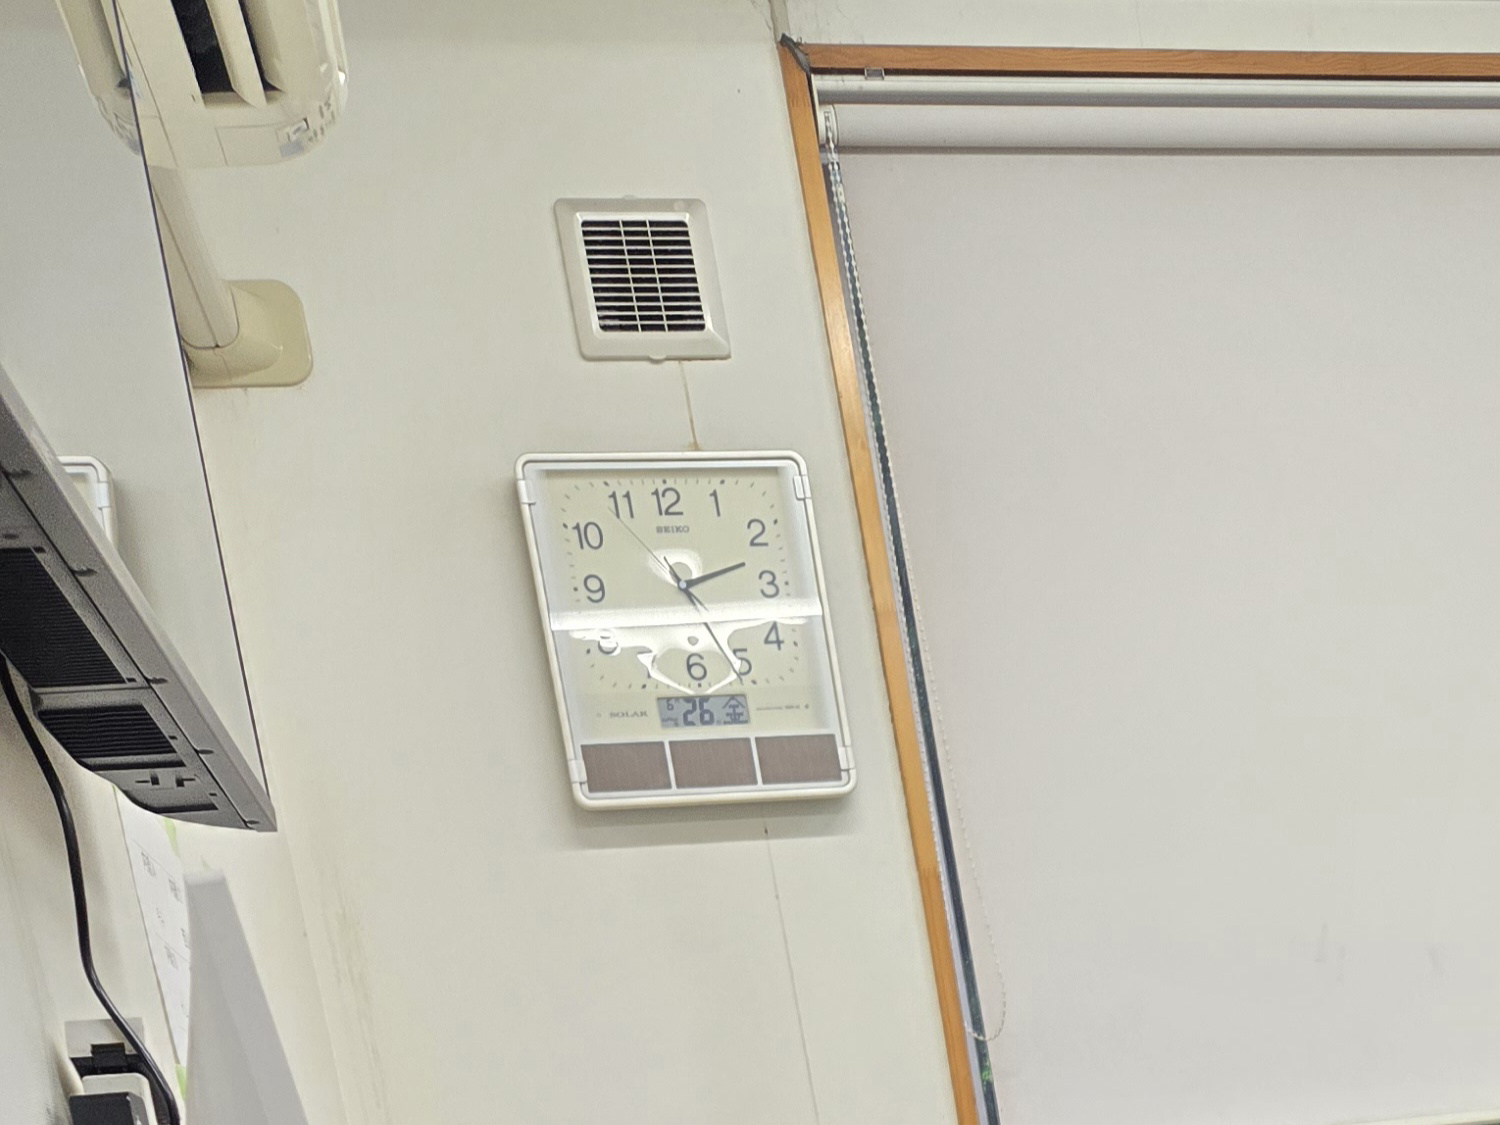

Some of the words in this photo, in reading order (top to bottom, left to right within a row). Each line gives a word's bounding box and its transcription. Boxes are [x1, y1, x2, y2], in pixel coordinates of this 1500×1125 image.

[608, 490, 634, 519] 11
[651, 487, 684, 516] 12
[709, 489, 721, 517] 1
[572, 522, 604, 550] 10
[656, 525, 690, 534] SEIKO
[746, 518, 769, 546] 2
[583, 574, 606, 603] 9
[758, 570, 780, 598] 3
[763, 620, 785, 651] 4
[686, 653, 707, 681] 6
[732, 648, 752, 676] 5
[609, 710, 648, 719] SOLAR
[683, 696, 714, 726] 26
[722, 695, 749, 725] 金
